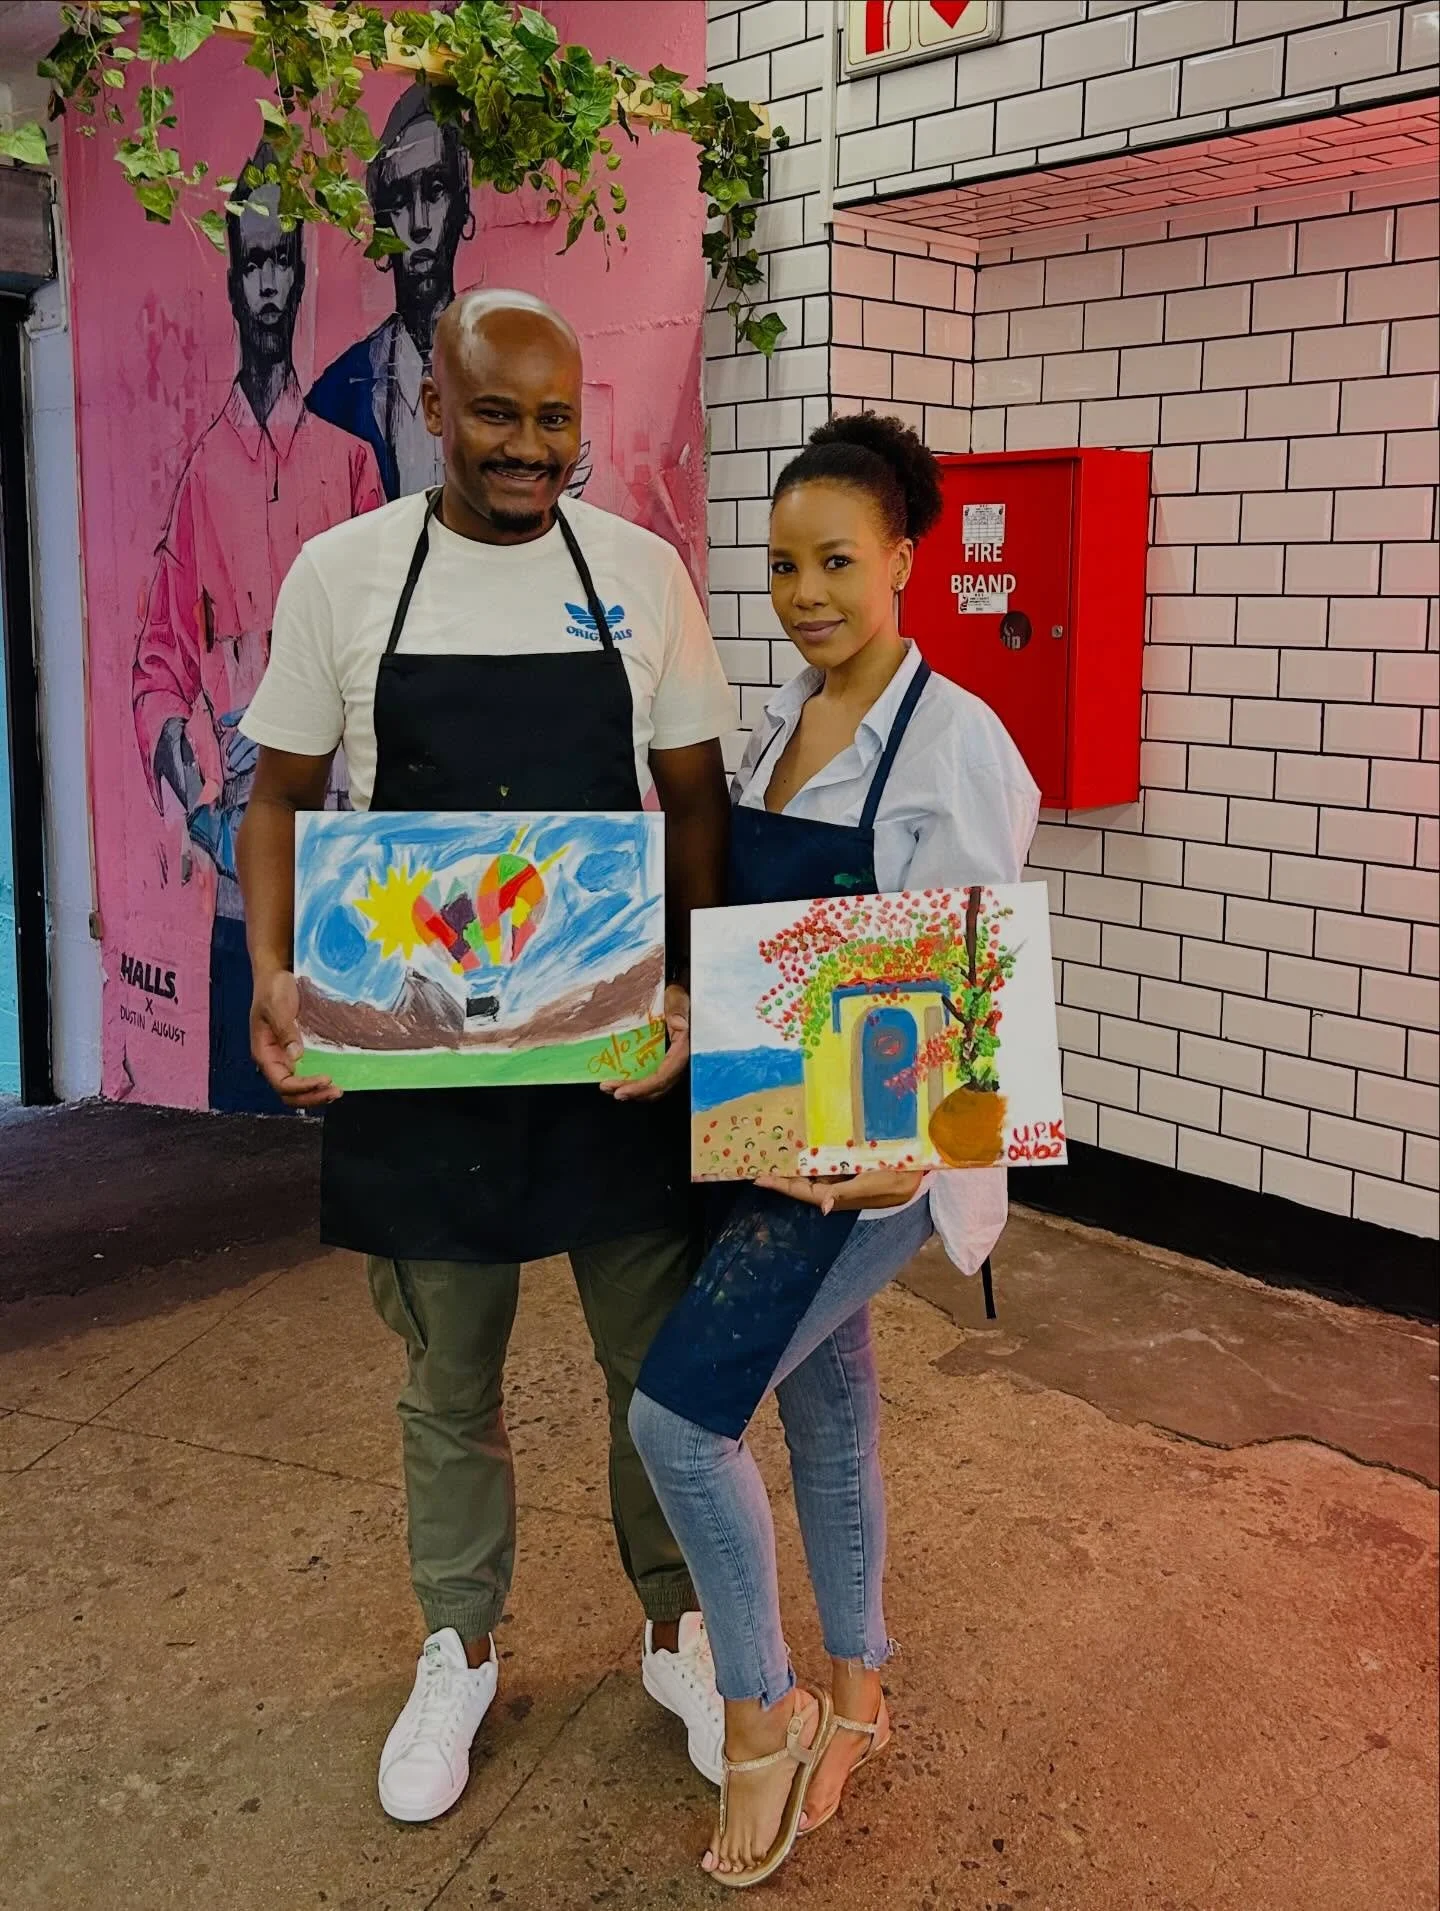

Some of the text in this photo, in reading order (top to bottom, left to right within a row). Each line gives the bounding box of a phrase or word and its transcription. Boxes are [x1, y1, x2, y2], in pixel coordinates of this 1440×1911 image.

[964, 543, 1003, 563] FIRE
[950, 573, 1017, 594] BRAND
[566, 625, 633, 641] ORIGALS
[120, 1005, 186, 1047] DUSTIN AUGUST
[1008, 1141, 1064, 1161] 04/02
